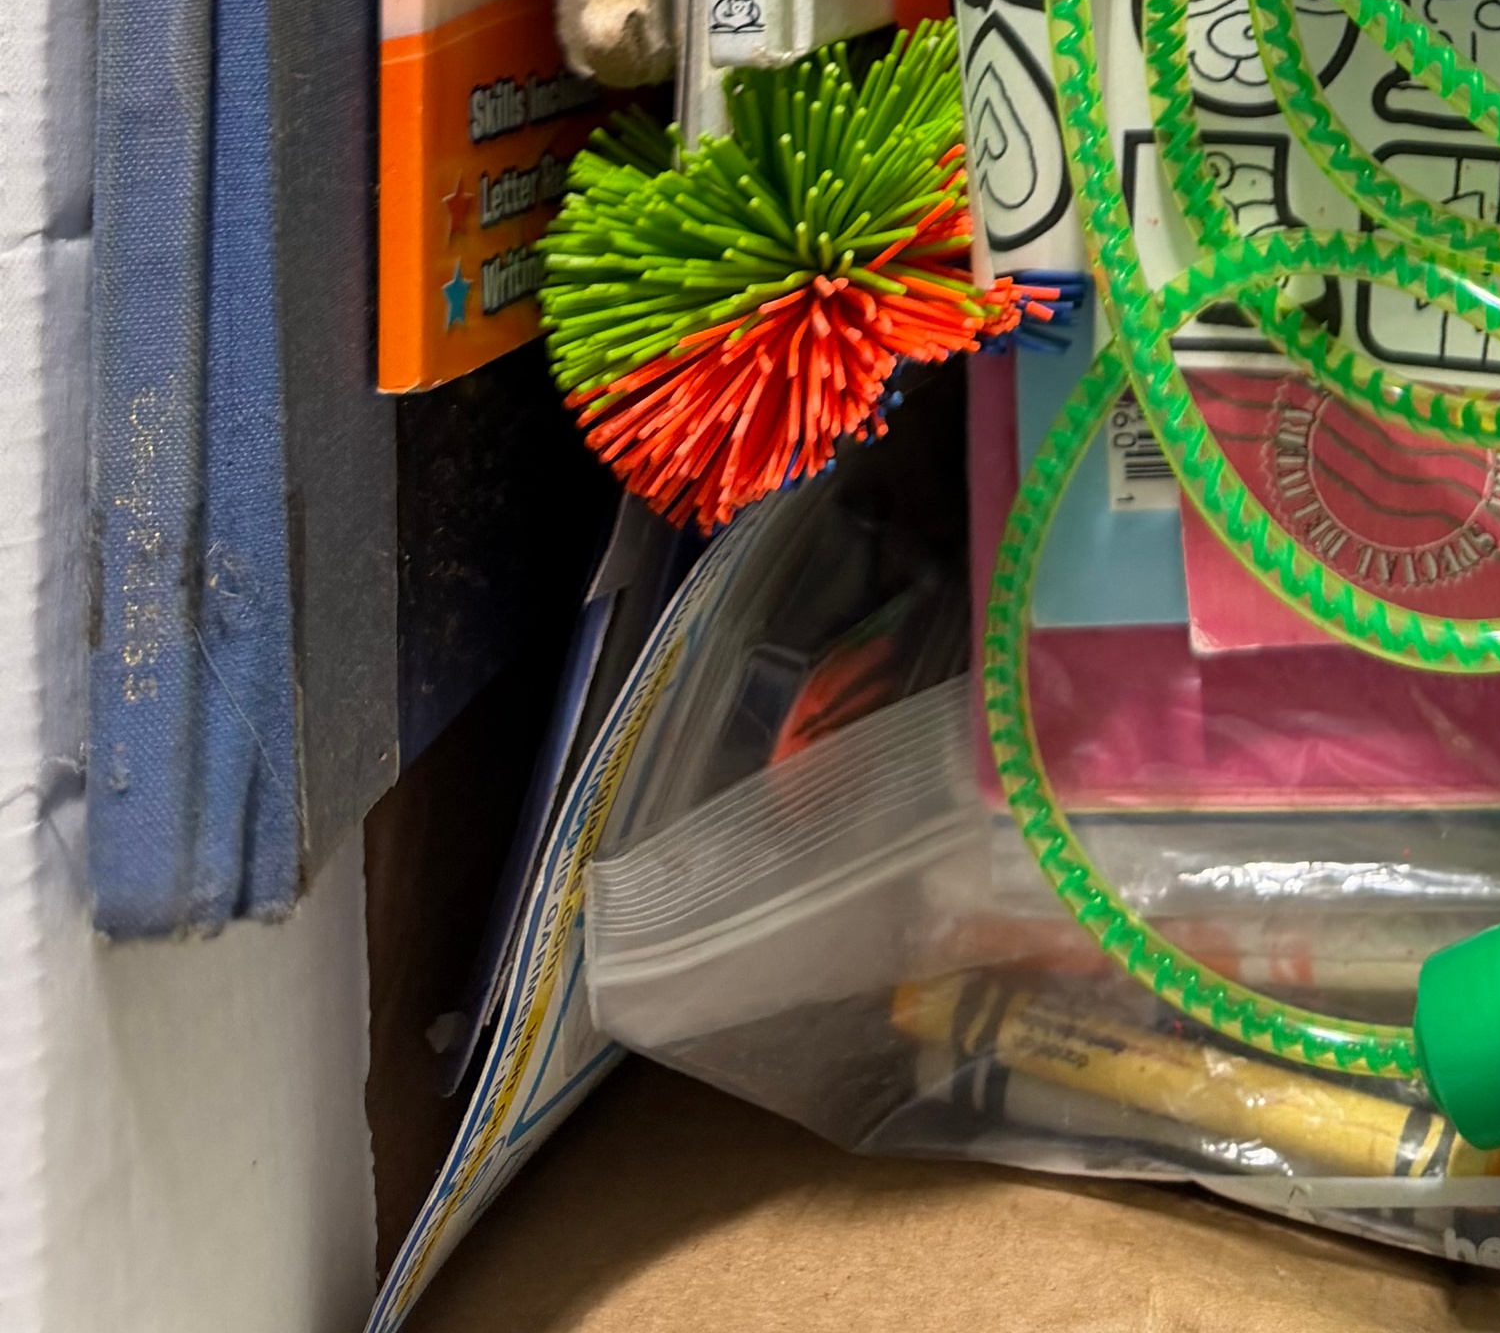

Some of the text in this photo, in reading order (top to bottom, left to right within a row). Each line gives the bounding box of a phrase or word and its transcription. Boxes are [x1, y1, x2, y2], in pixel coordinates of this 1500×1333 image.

[469, 73, 528, 145] Skills
[480, 163, 541, 229] Letter
[480, 247, 542, 317] Writin
[1350, 523, 1497, 589] SPECIAL
